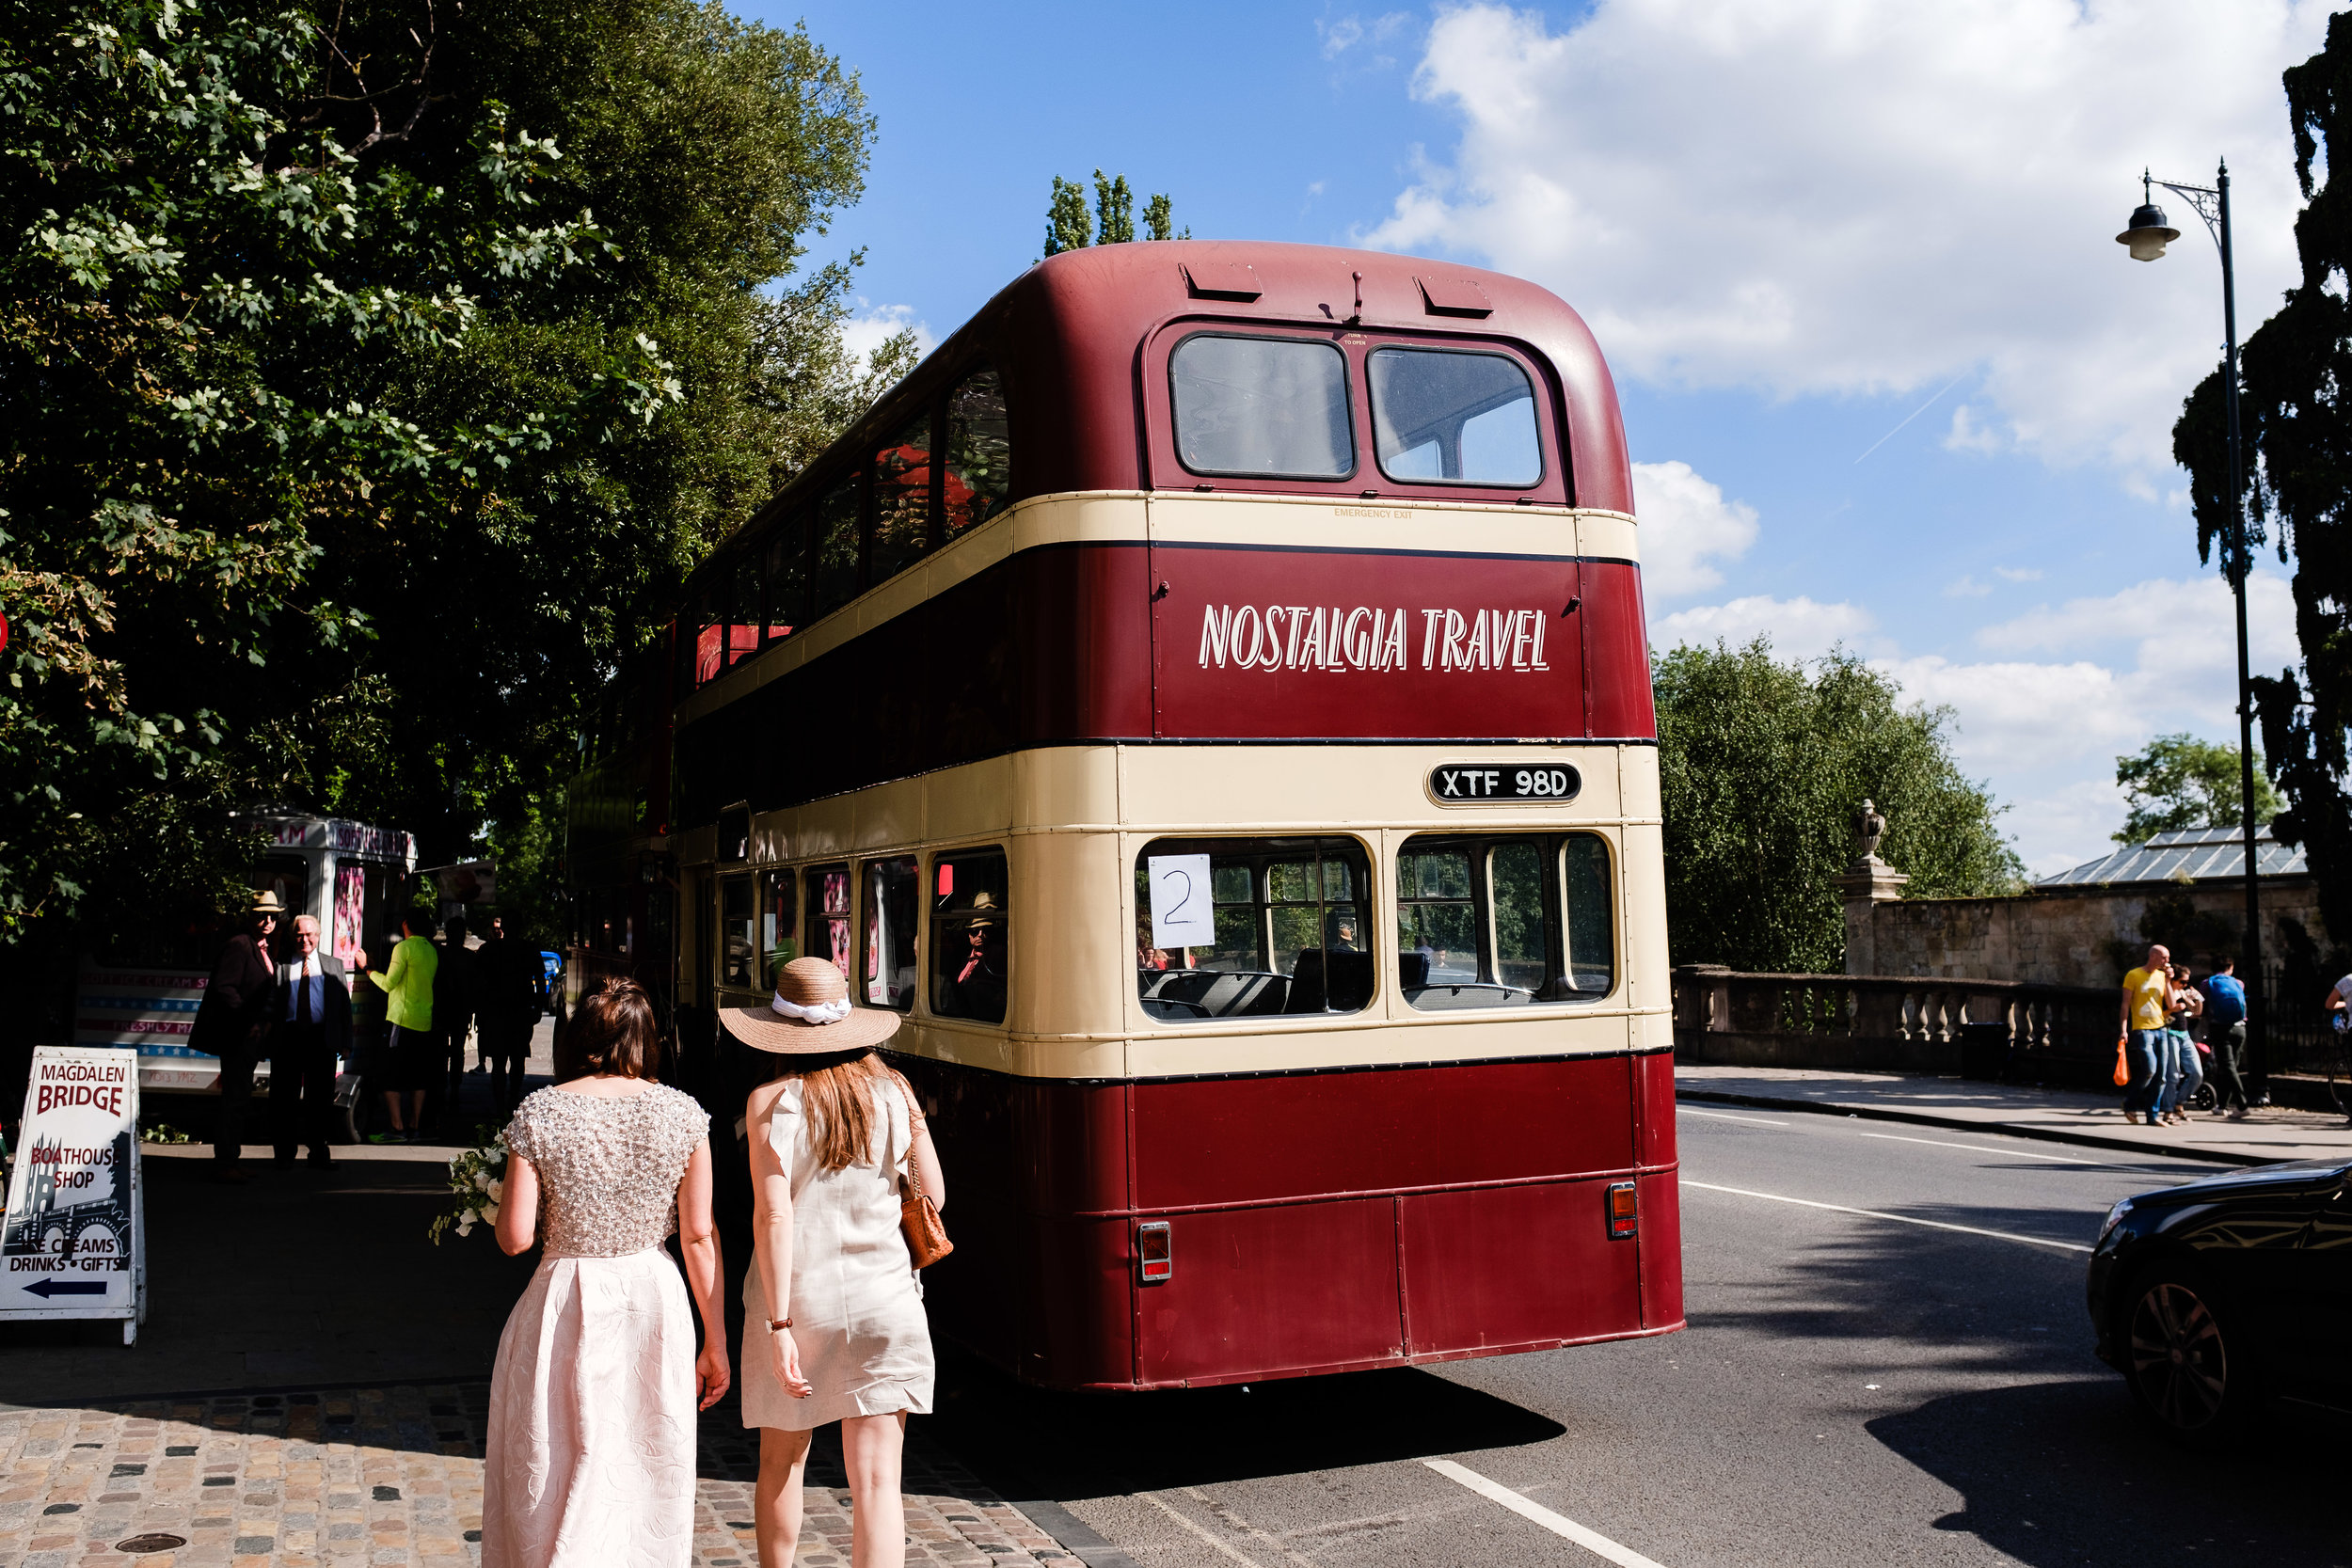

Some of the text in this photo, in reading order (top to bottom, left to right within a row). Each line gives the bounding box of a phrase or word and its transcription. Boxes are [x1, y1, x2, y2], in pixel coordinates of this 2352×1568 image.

[1334, 508, 1413, 519] EMERGENCY EXIT
[1199, 604, 1549, 672] NOSTALGIA TRAVEL
[1442, 770, 1566, 796] XTF 98D
[339, 828, 361, 847] SOFT
[1163, 870, 1196, 925] 2
[145, 975, 193, 988] CREAM
[113, 1021, 171, 1032] FRESHLY
[41, 1065, 125, 1082] MAGDALEN
[38, 1085, 122, 1117] BRIDGE
[31, 1148, 120, 1165] BOATHOUSE
[54, 1171, 95, 1188] SHOP
[22, 1239, 115, 1253] ICE CREAMS
[10, 1257, 120, 1272] DRINKS GIFTS
